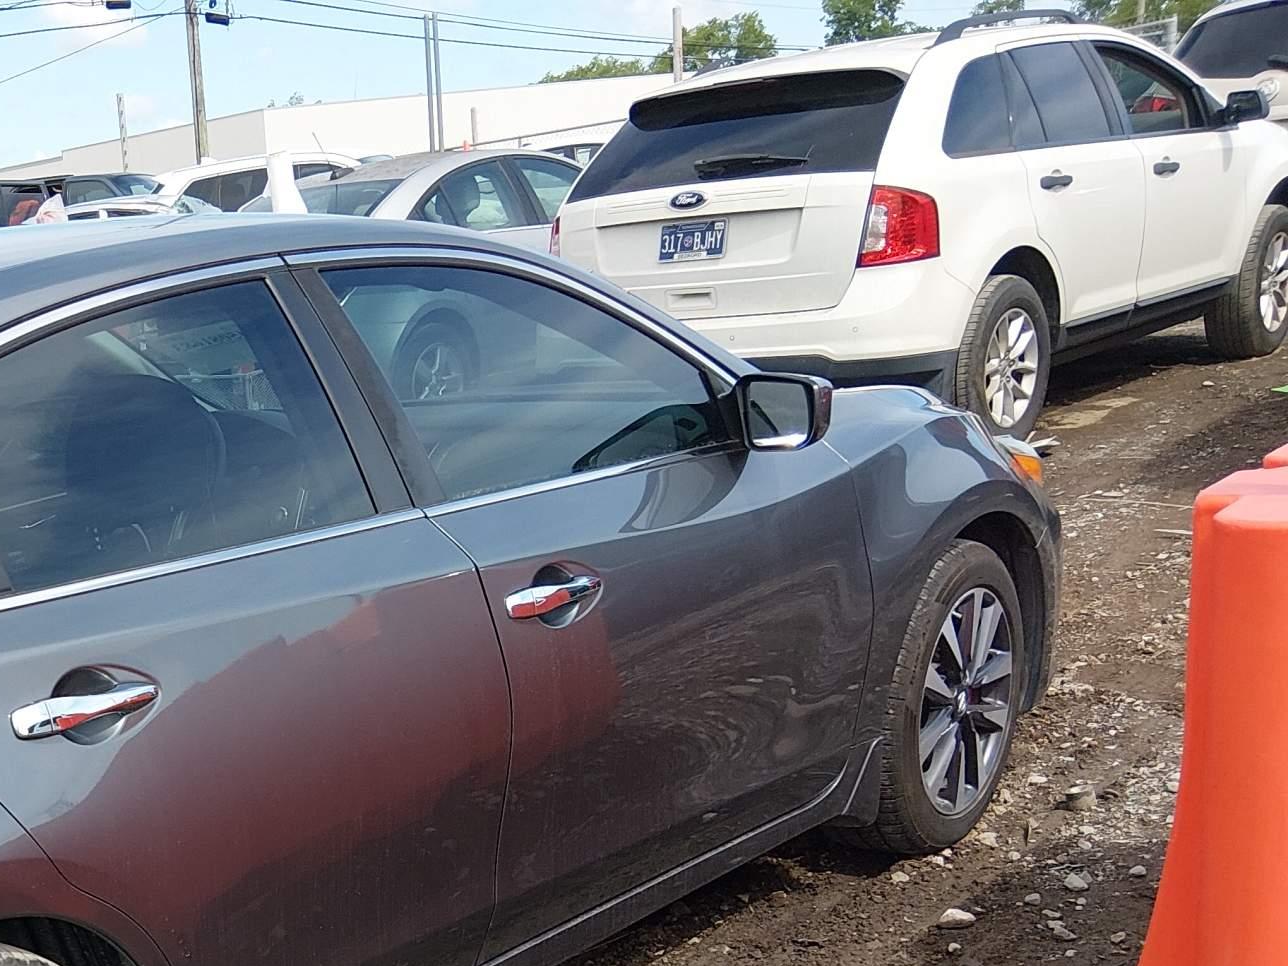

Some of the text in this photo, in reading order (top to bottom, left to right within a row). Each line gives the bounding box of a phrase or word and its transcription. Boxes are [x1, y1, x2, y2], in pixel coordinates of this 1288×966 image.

[675, 193, 699, 205] Ford
[661, 231, 723, 253] 317 BJHY
